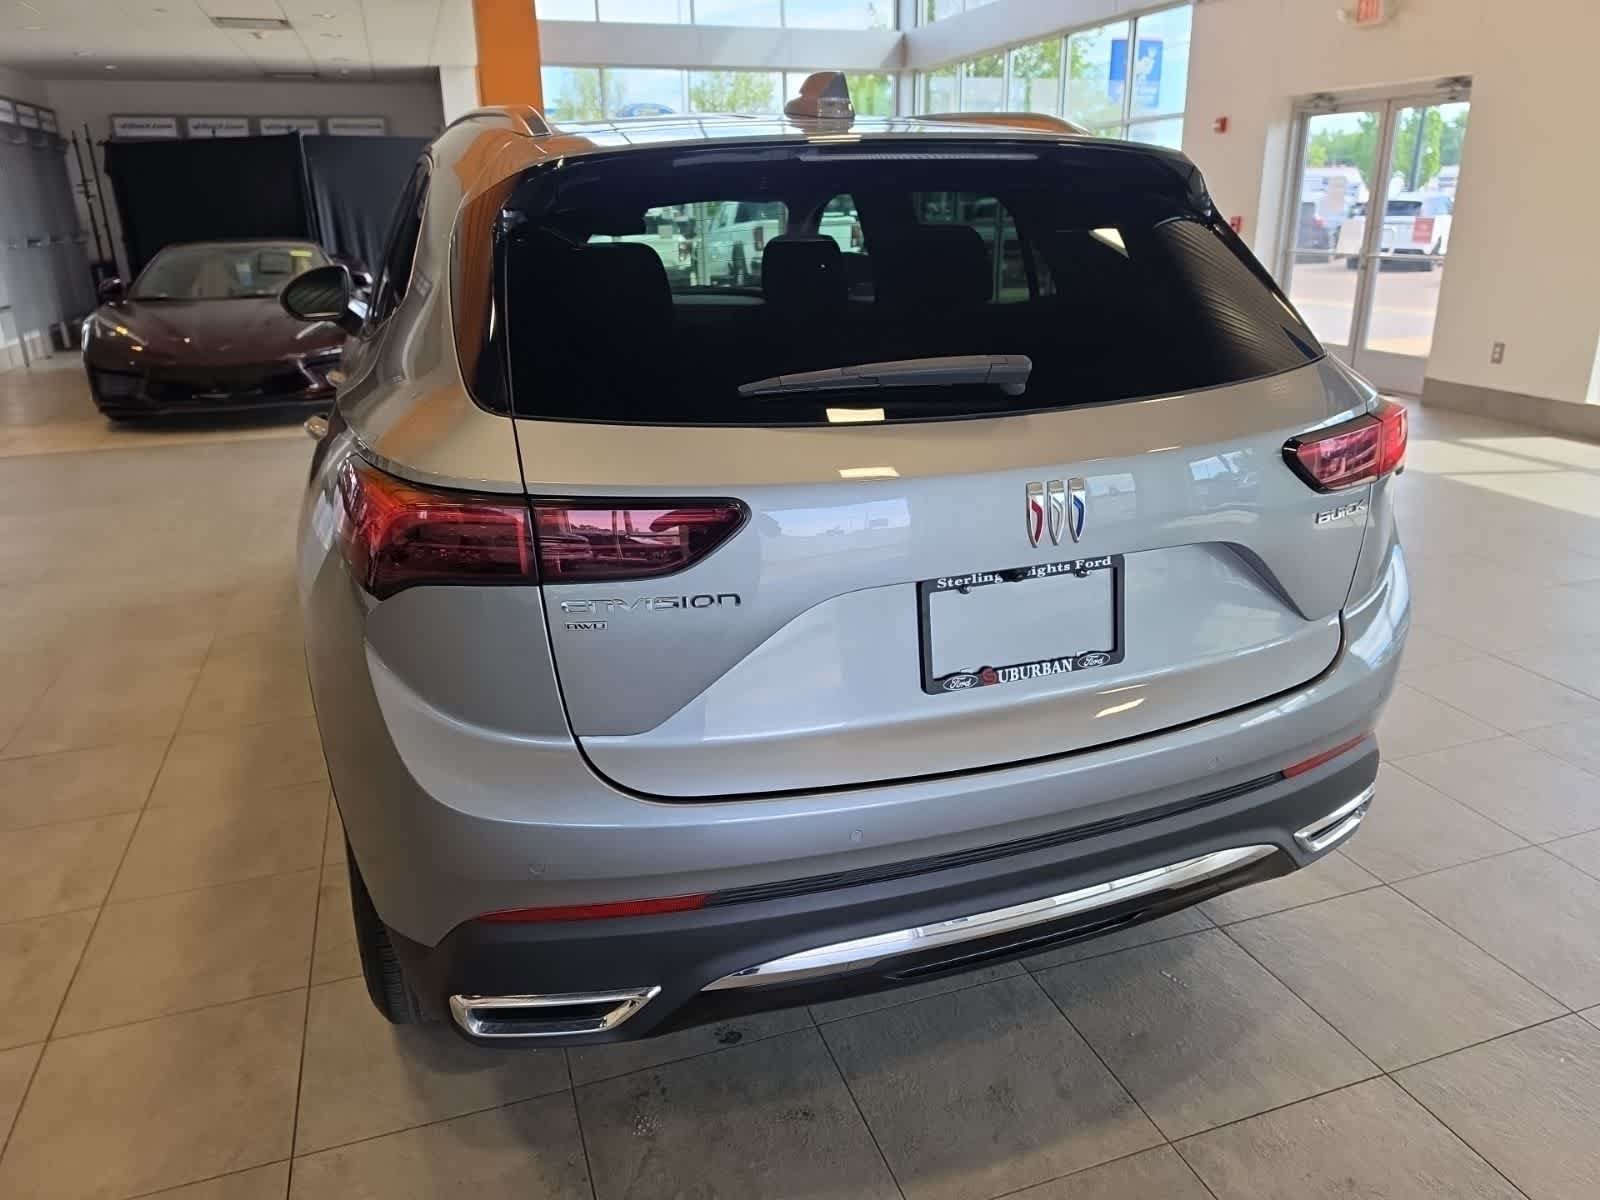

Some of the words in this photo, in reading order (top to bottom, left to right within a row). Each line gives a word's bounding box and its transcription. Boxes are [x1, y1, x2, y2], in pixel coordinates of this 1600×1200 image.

[936, 572, 1004, 589] Sterling
[1010, 562, 1071, 580] ights
[1074, 556, 1113, 570] Ford
[560, 593, 742, 614] ENVISION
[981, 658, 1074, 685] SUBURBAN
[1083, 654, 1105, 668] Ford
[949, 674, 973, 688] Ford
